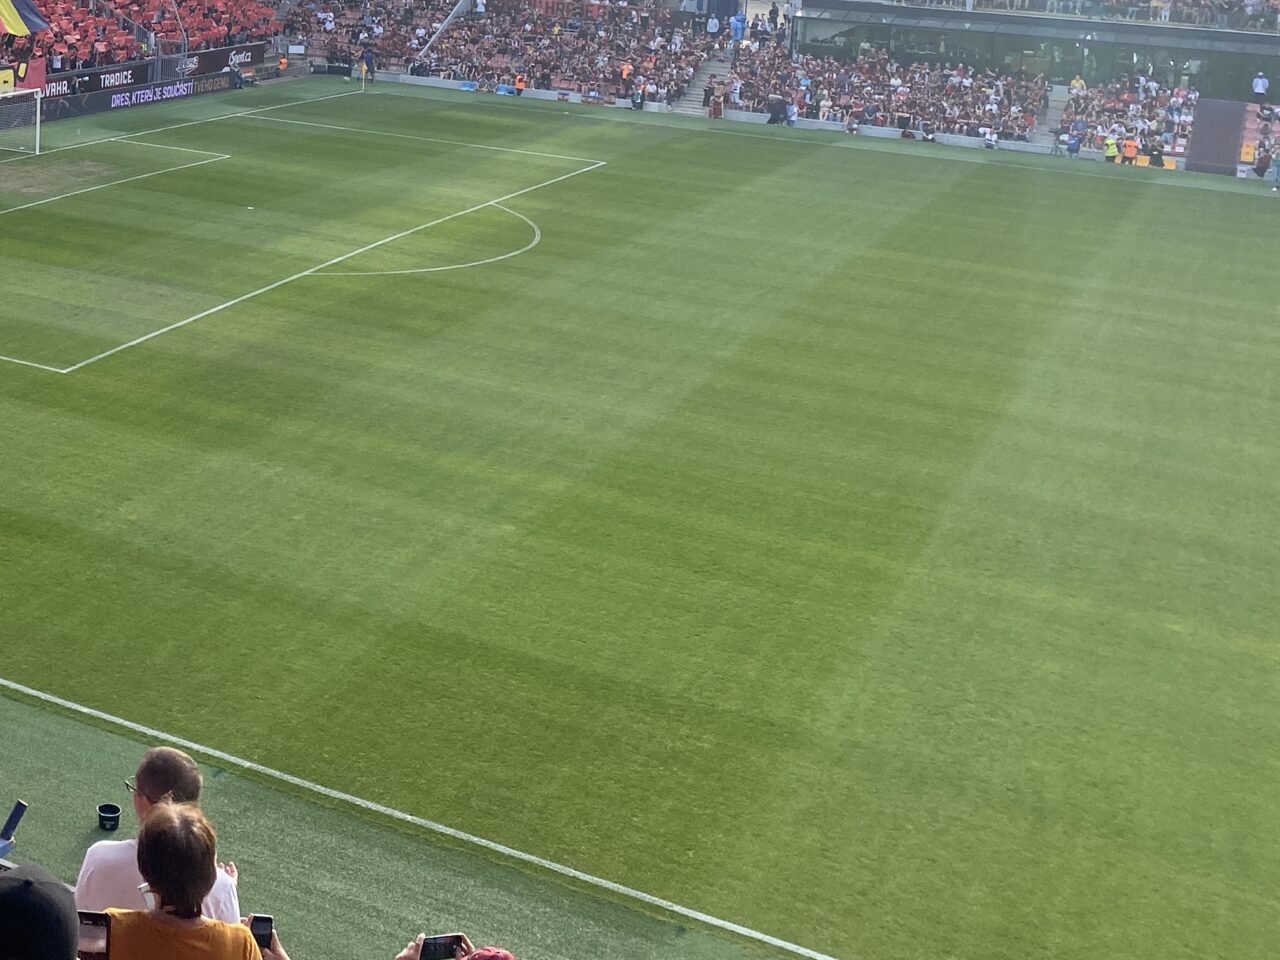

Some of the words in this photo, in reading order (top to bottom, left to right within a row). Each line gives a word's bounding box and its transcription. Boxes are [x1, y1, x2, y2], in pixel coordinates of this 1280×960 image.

[100, 70, 135, 88] TRADICE.
[111, 92, 131, 108] DRES,
[132, 87, 153, 105] KTERÝ
[154, 87, 163, 101] JE
[163, 78, 196, 99] SOUČÁSTÍ
